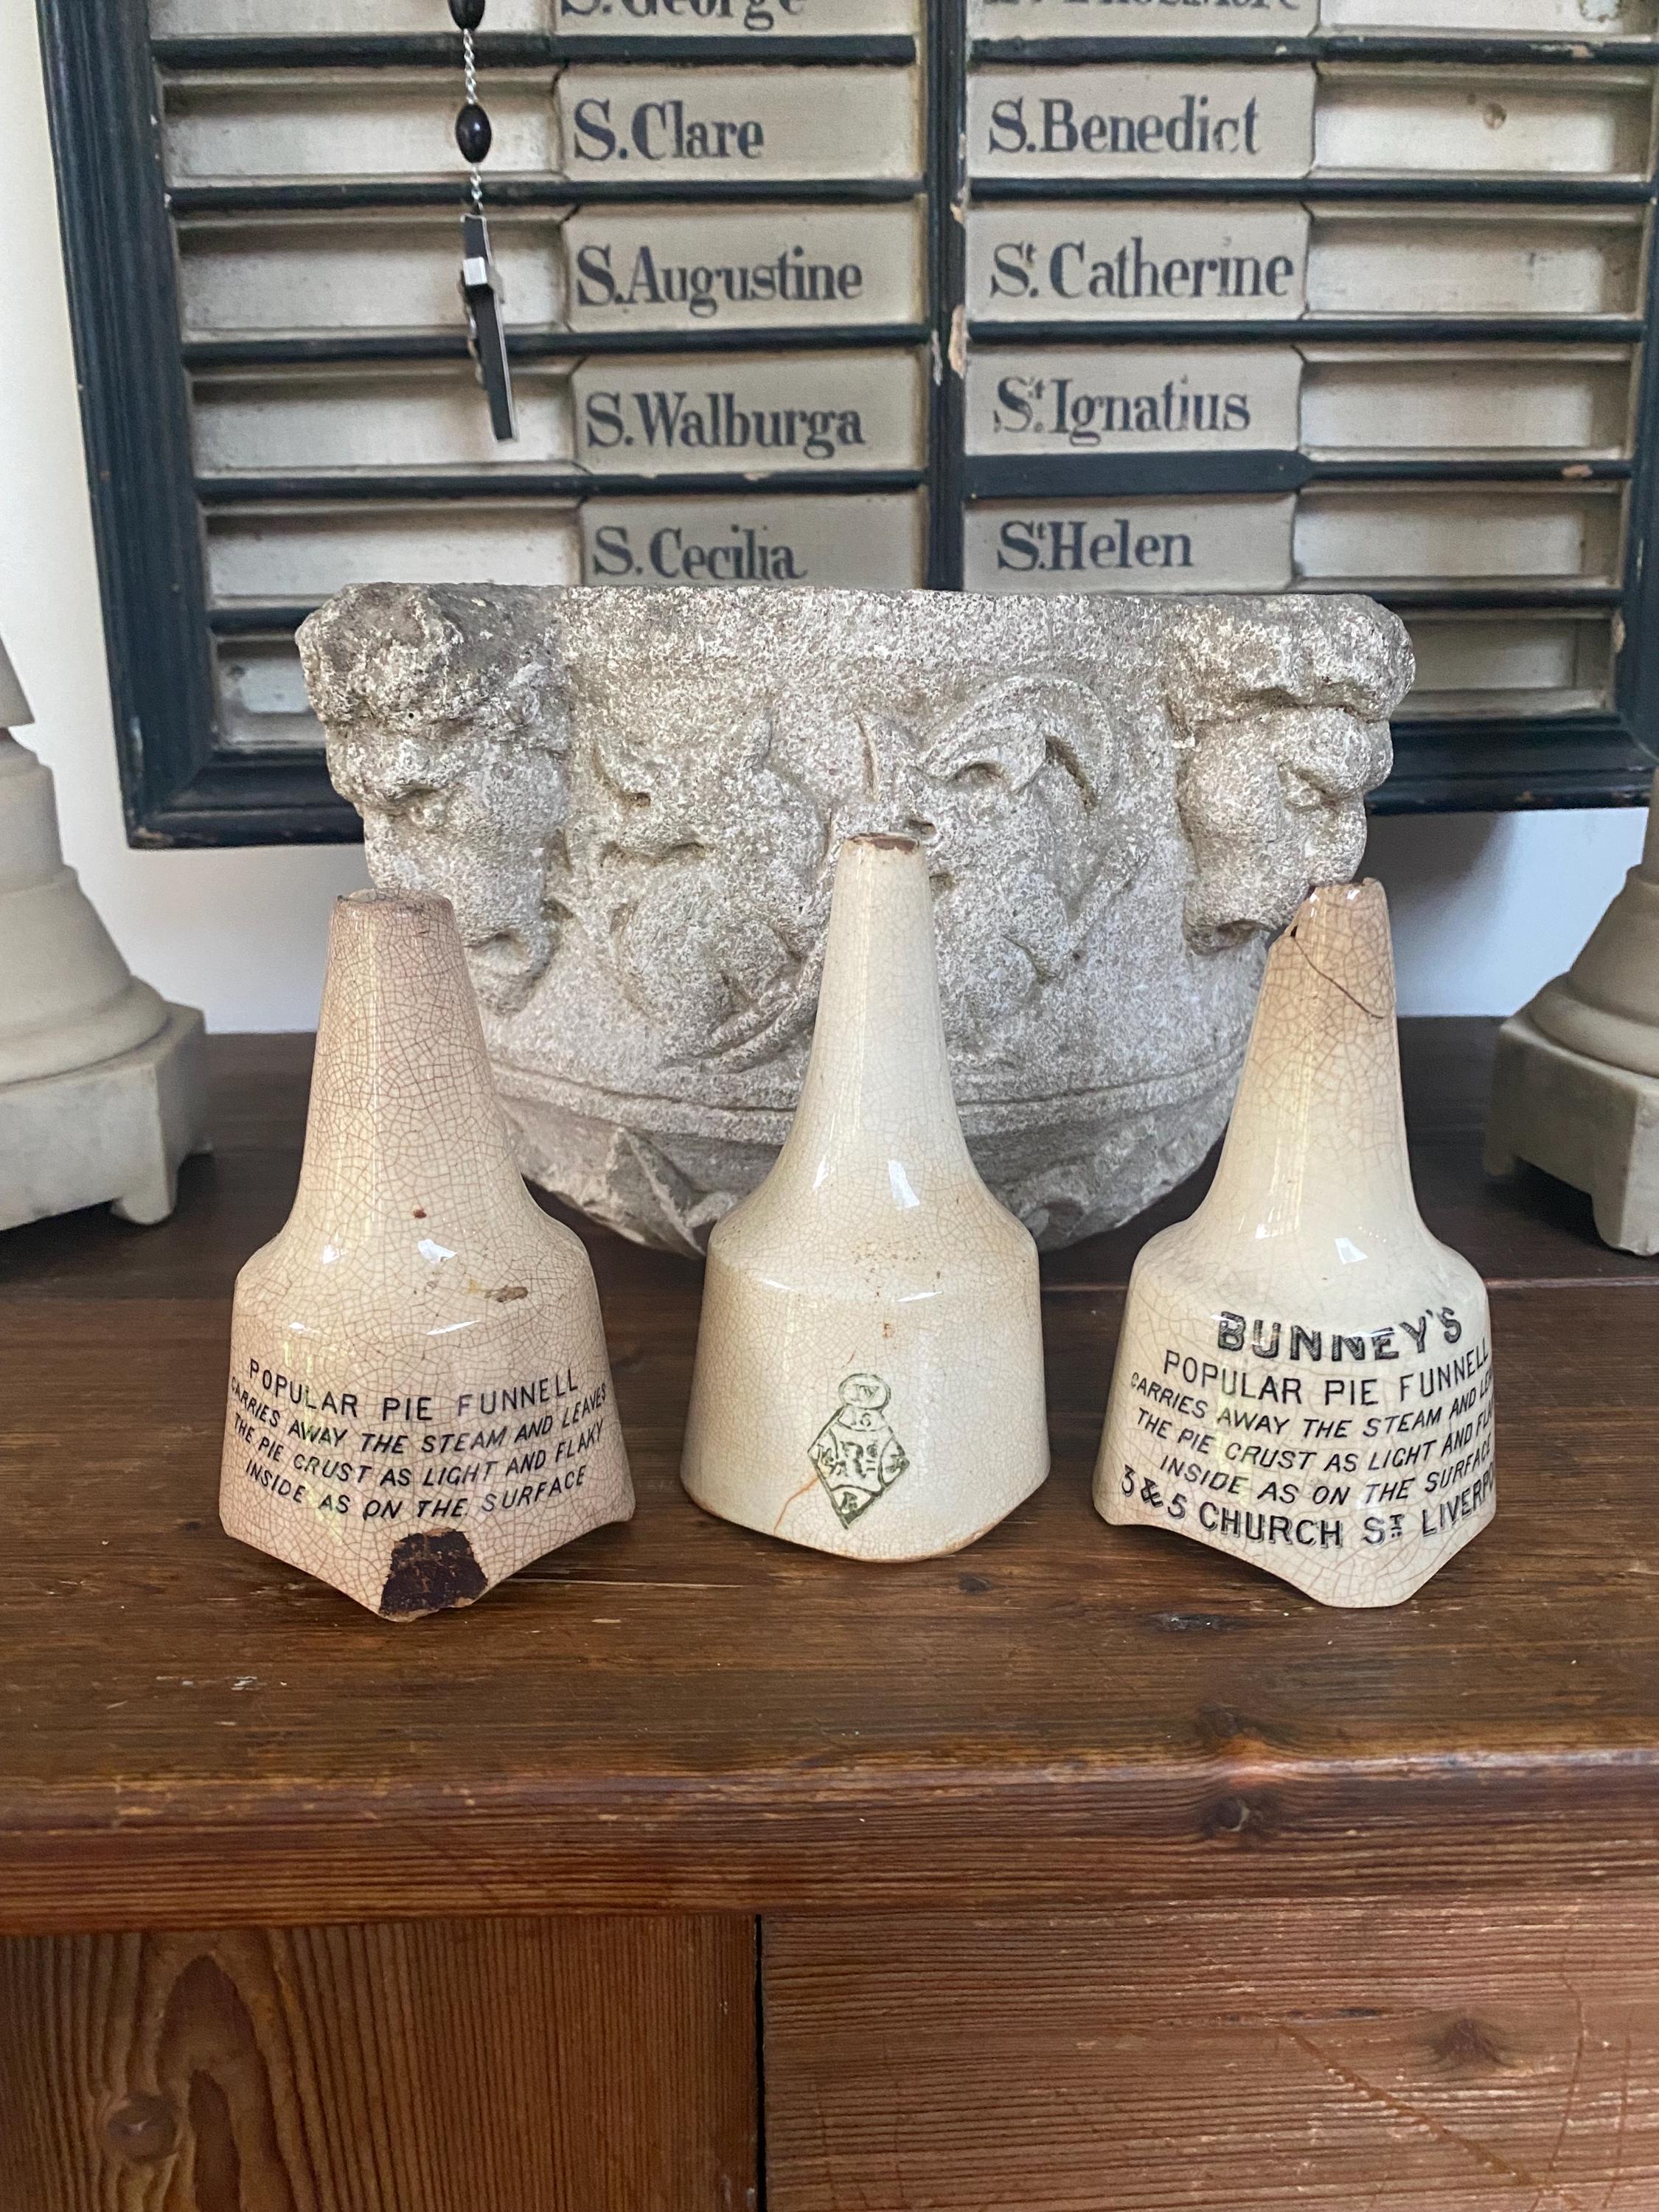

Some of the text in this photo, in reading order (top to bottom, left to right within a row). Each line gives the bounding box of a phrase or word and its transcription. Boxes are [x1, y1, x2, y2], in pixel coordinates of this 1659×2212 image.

[1218, 1307, 1462, 1362] BUNNEY'S
[249, 1358, 578, 1422] POPULAR PIE FUNNELL
[1163, 1338, 1489, 1405] POPULAR PIE FUNNELL
[232, 1376, 606, 1454] CARRIES AWAY THE STEAM AND LEAVES
[1131, 1372, 1208, 1419] CARRIES
[1217, 1407, 1290, 1435] AWAY
[1303, 1419, 1352, 1438] THE
[1363, 1407, 1442, 1437] STEAM
[1449, 1387, 1476, 1419] AND
[235, 1412, 603, 1486] THE PIE CRUST AS LIGHT AND FLAKY
[1138, 1407, 1172, 1439] THE
[1178, 1427, 1216, 1454] PIE
[1225, 1441, 1317, 1470] CRUST
[1324, 1453, 1359, 1472] AS
[1368, 1439, 1437, 1471] LIGHT
[1441, 1422, 1473, 1457] AND
[1159, 1433, 1492, 1506] INSIDE AS ON THE SURFACE
[246, 1459, 587, 1520] INSIDE AS ON THE SURFACE
[1199, 1501, 1343, 1548] CHURCH
